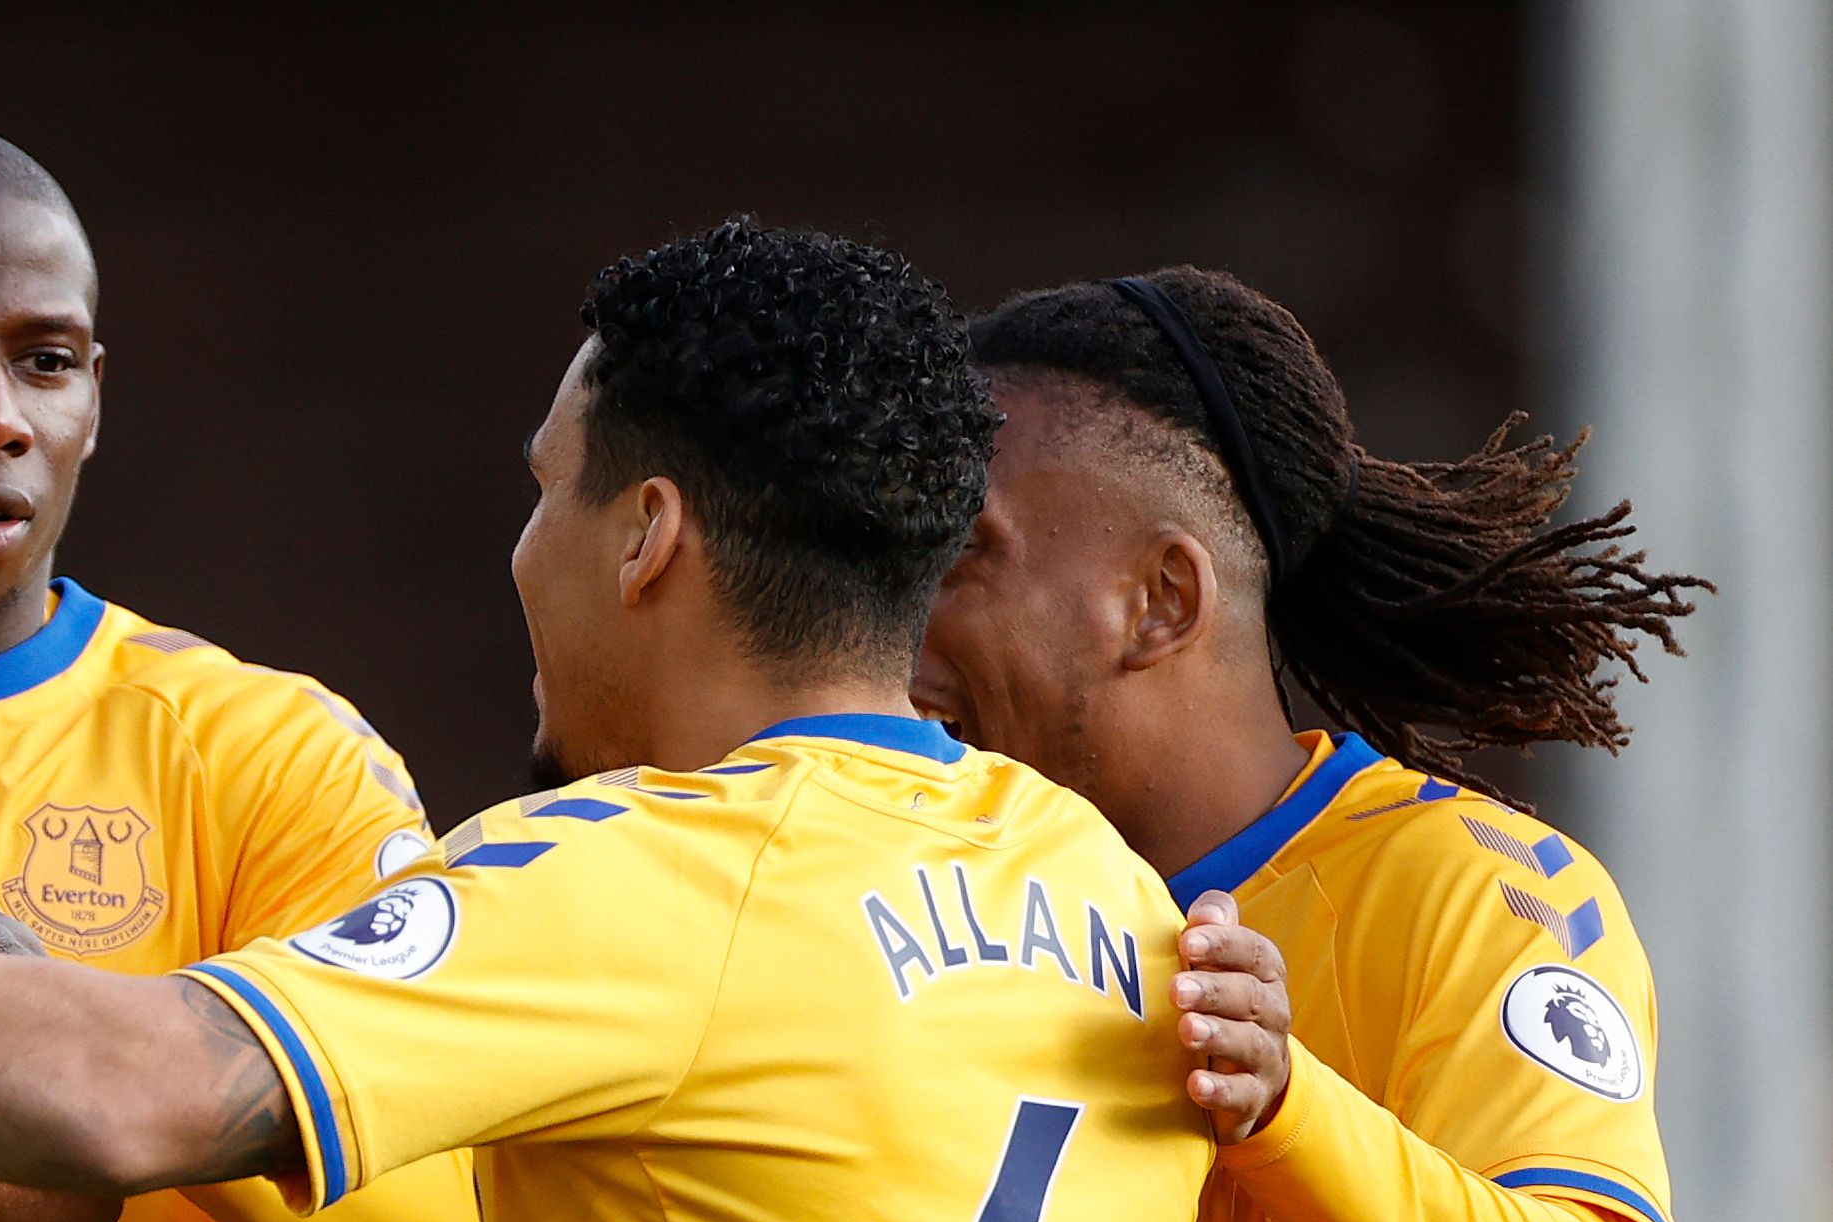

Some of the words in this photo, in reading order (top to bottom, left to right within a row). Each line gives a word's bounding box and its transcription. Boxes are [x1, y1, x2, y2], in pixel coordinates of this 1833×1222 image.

[41, 883, 126, 909] Everton
[319, 942, 368, 965] Premier
[371, 944, 418, 966] League
[859, 860, 1145, 1023] ALLAN
